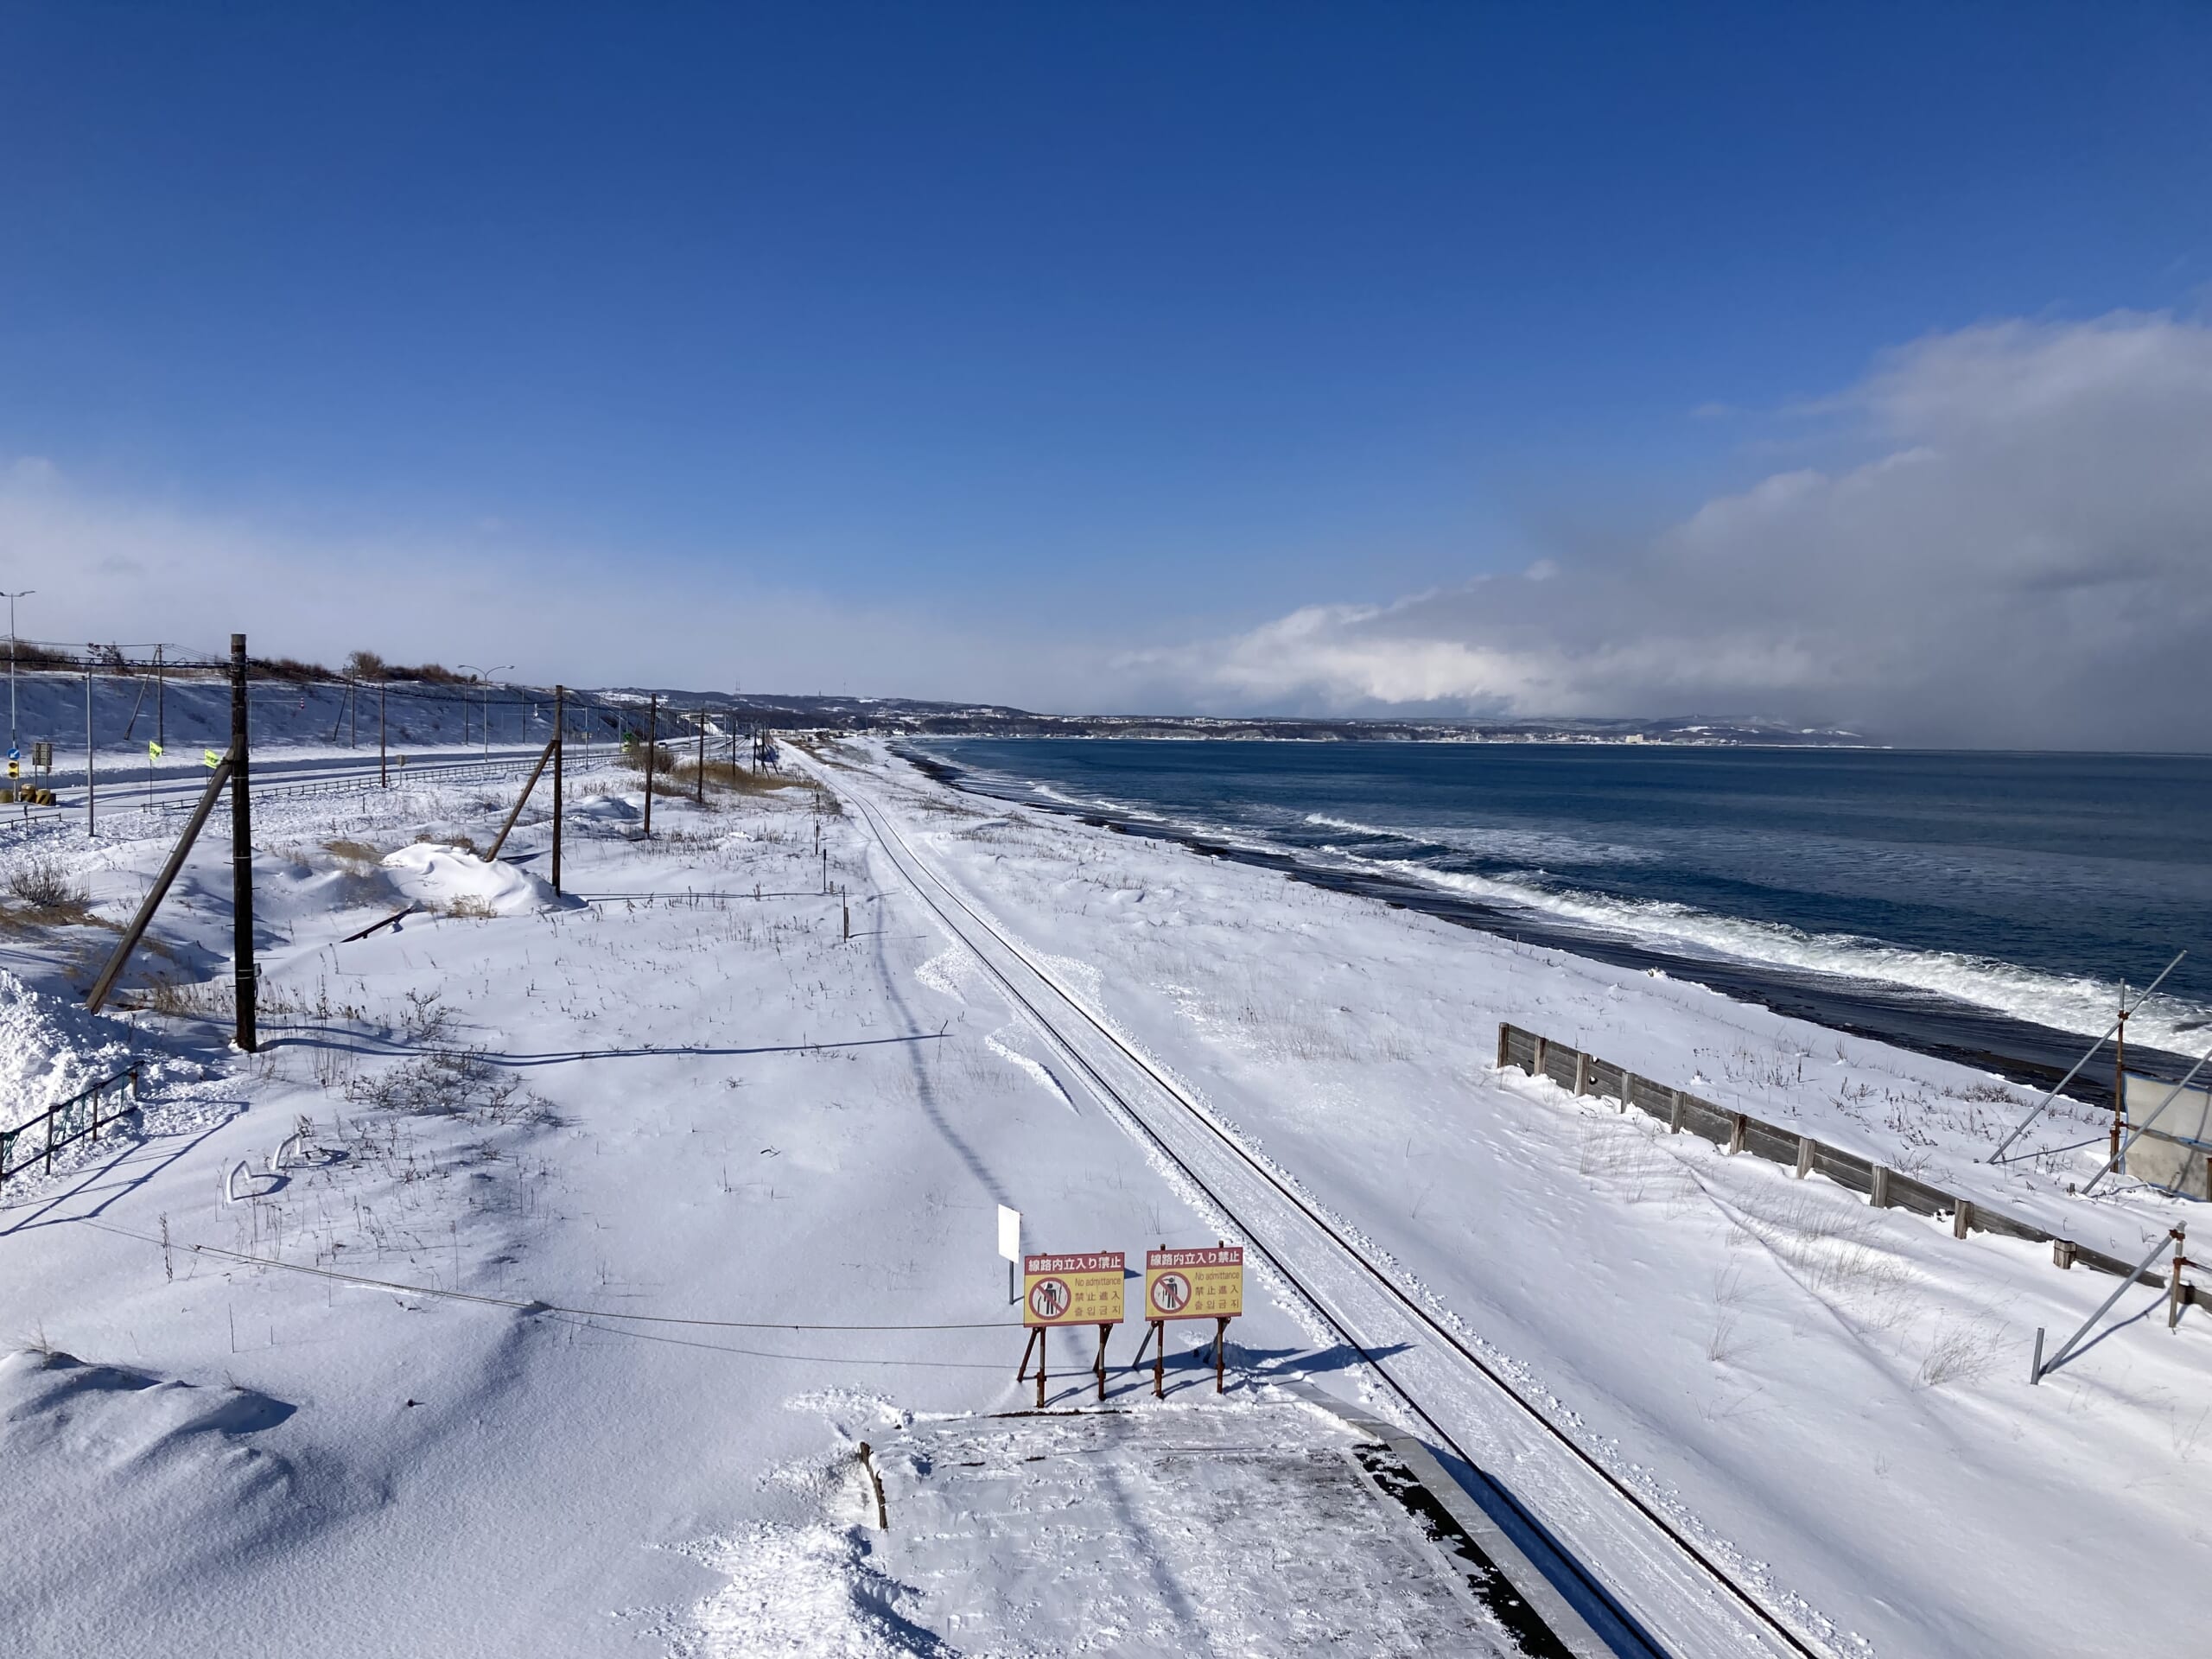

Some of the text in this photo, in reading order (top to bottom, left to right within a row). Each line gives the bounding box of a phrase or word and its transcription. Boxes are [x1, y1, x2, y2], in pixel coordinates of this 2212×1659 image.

[1028, 1255, 1122, 1272] 線路内立入り禁止
[1150, 1251, 1240, 1266] 線路内立入り禁止
[1075, 1277, 1121, 1287] No admittance
[1195, 1271, 1240, 1281] No admittance
